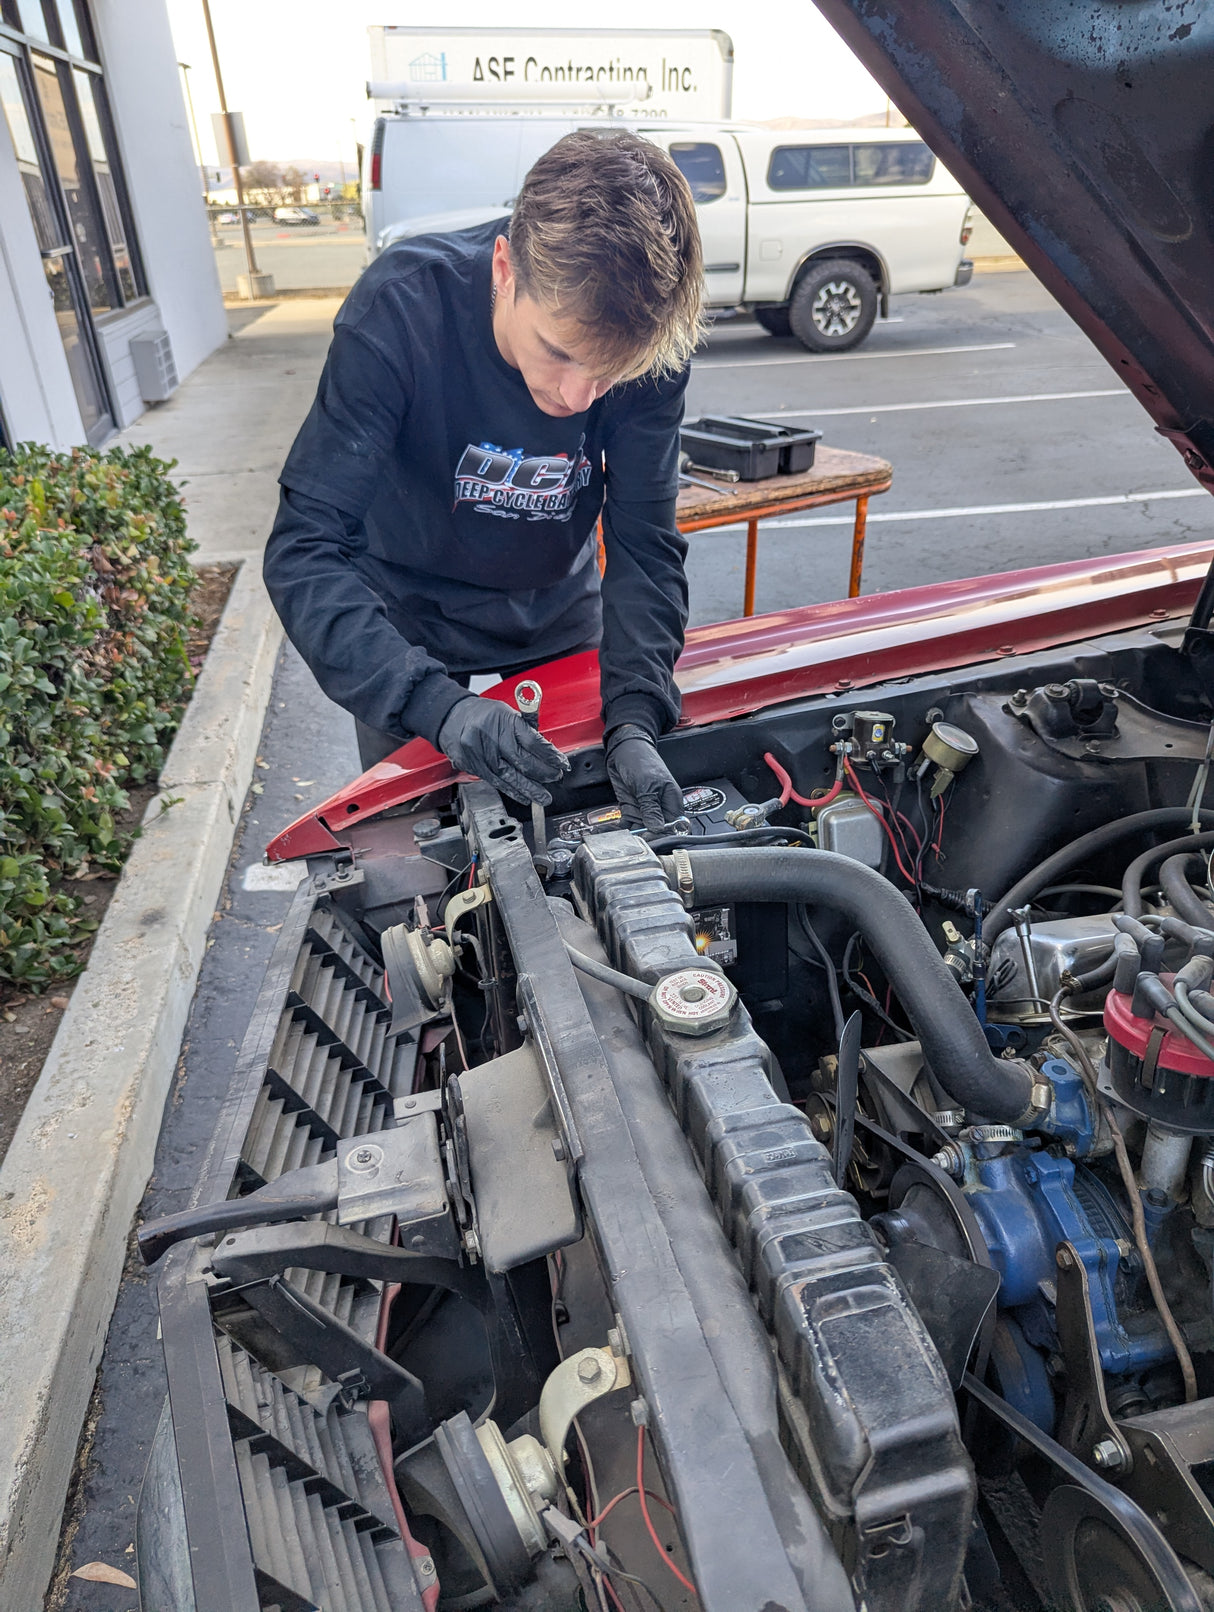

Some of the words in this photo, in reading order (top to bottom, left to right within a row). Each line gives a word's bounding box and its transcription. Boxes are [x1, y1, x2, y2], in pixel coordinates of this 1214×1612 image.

[661, 57, 698, 92] Inc.
[492, 489, 544, 511] CYCLE
[526, 510, 574, 522] Dieg
[692, 973, 716, 981] CAUTION
